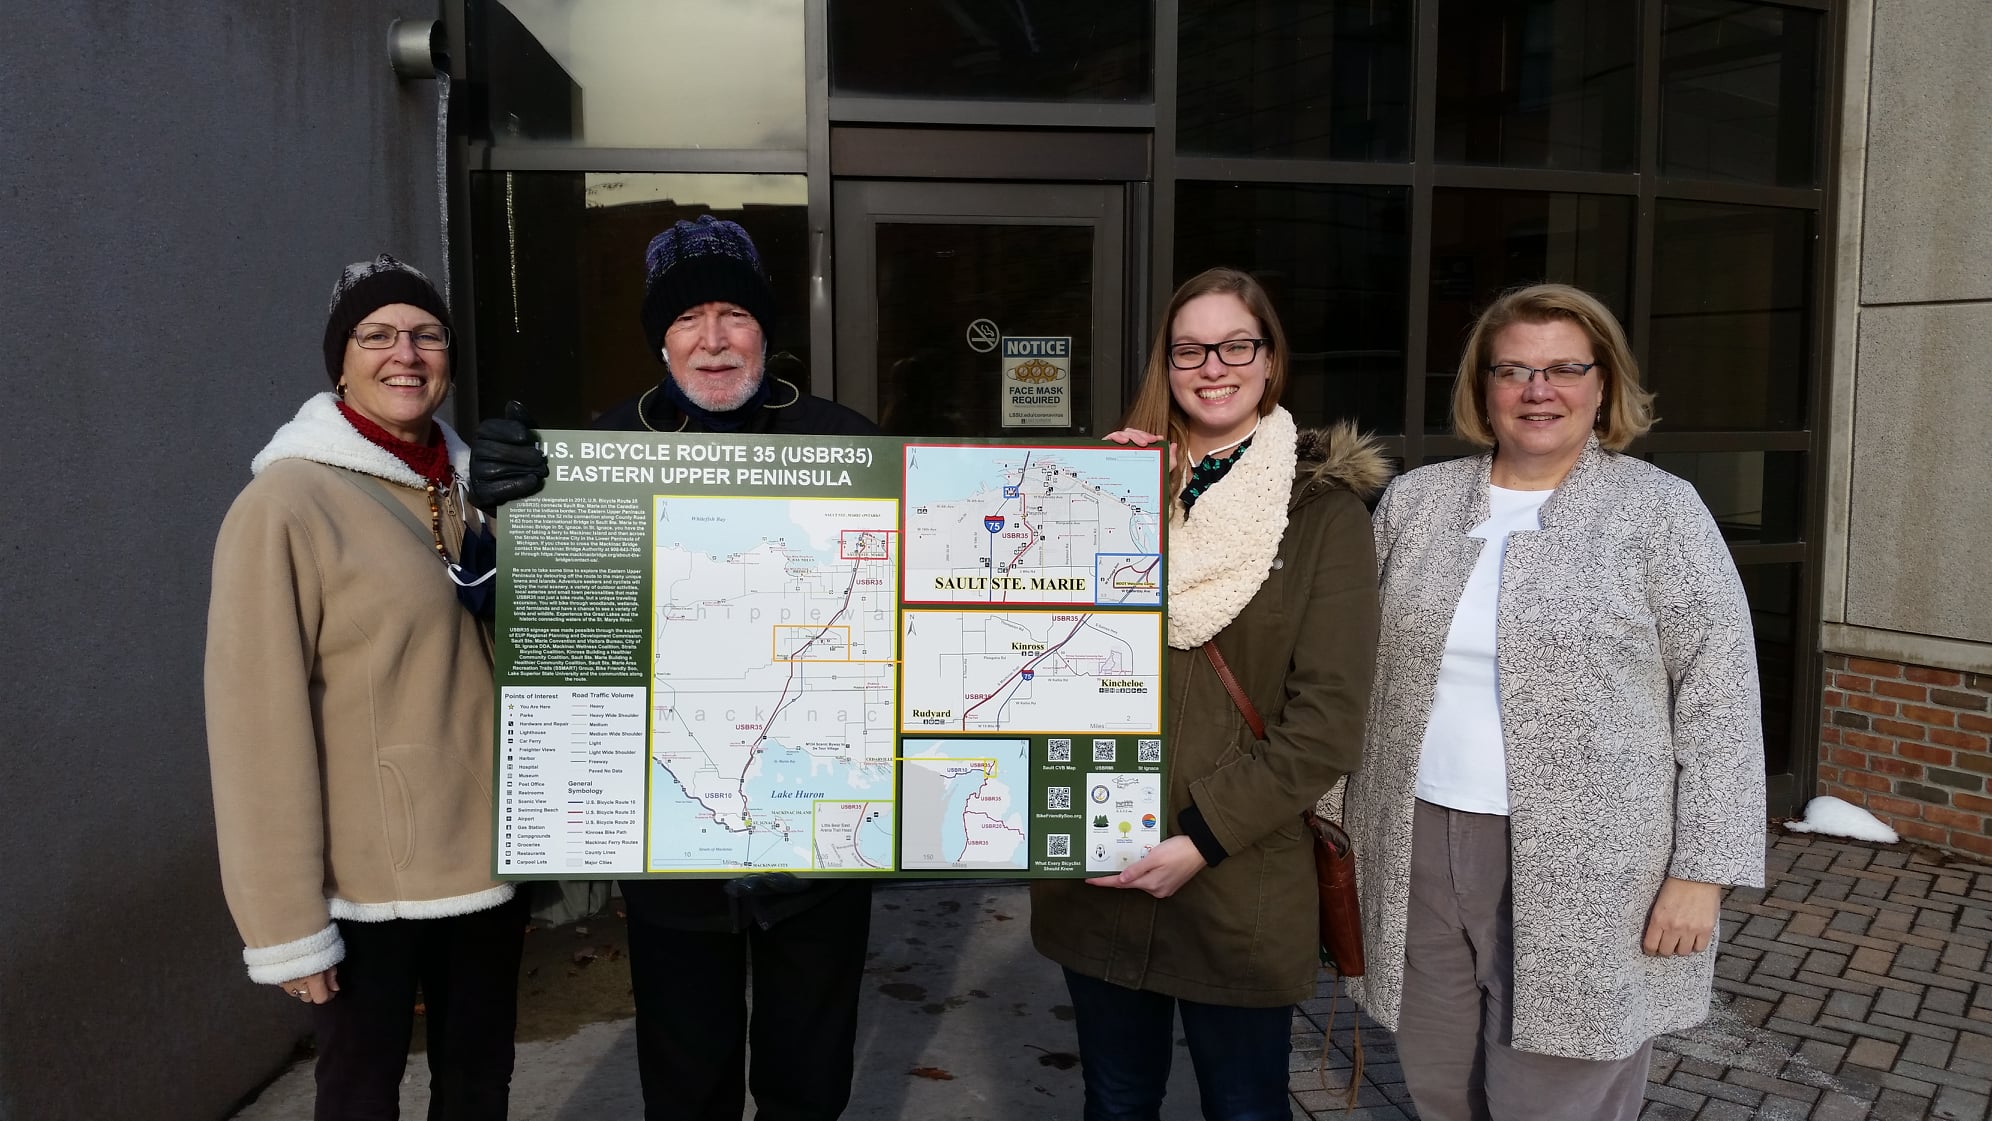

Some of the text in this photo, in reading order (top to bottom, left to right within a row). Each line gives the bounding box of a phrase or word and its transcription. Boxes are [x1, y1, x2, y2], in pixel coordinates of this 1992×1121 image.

[1007, 341, 1065, 355] NOTICE
[1009, 387, 1063, 395] FACE MASK
[1012, 396, 1060, 404] REQUIRED
[535, 441, 873, 468] U.S. BICYCLE ROUTE 35 (USBR35)
[557, 465, 852, 485] EASTERN UPPER PENINSULA
[989, 522, 1000, 531] 75
[935, 577, 1086, 590] SAULT STE. MARIE
[1011, 642, 1044, 650] Kinross
[1101, 679, 1144, 687] Kincheloe
[913, 709, 951, 719] Rudyard
[795, 791, 824, 799] Huron
